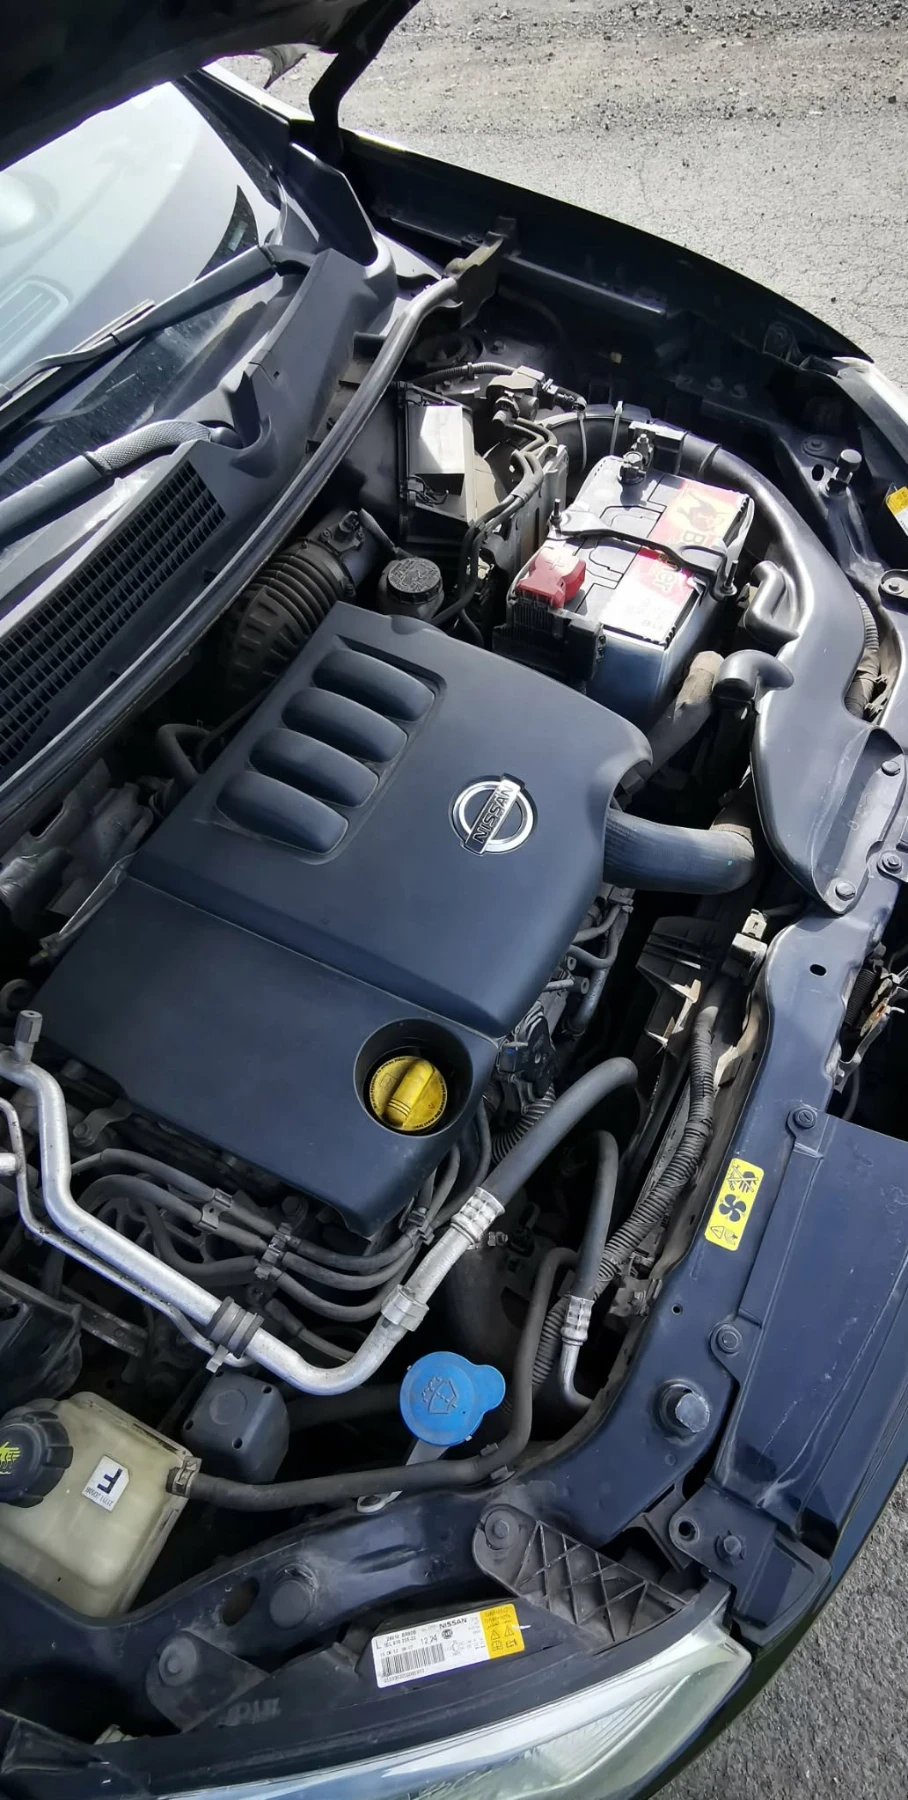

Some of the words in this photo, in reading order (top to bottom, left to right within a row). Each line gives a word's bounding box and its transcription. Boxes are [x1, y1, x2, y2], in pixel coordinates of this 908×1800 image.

[472, 785, 513, 844] NISSAN
[97, 1468, 123, 1494] F
[439, 1617, 468, 1629] NISSAN
